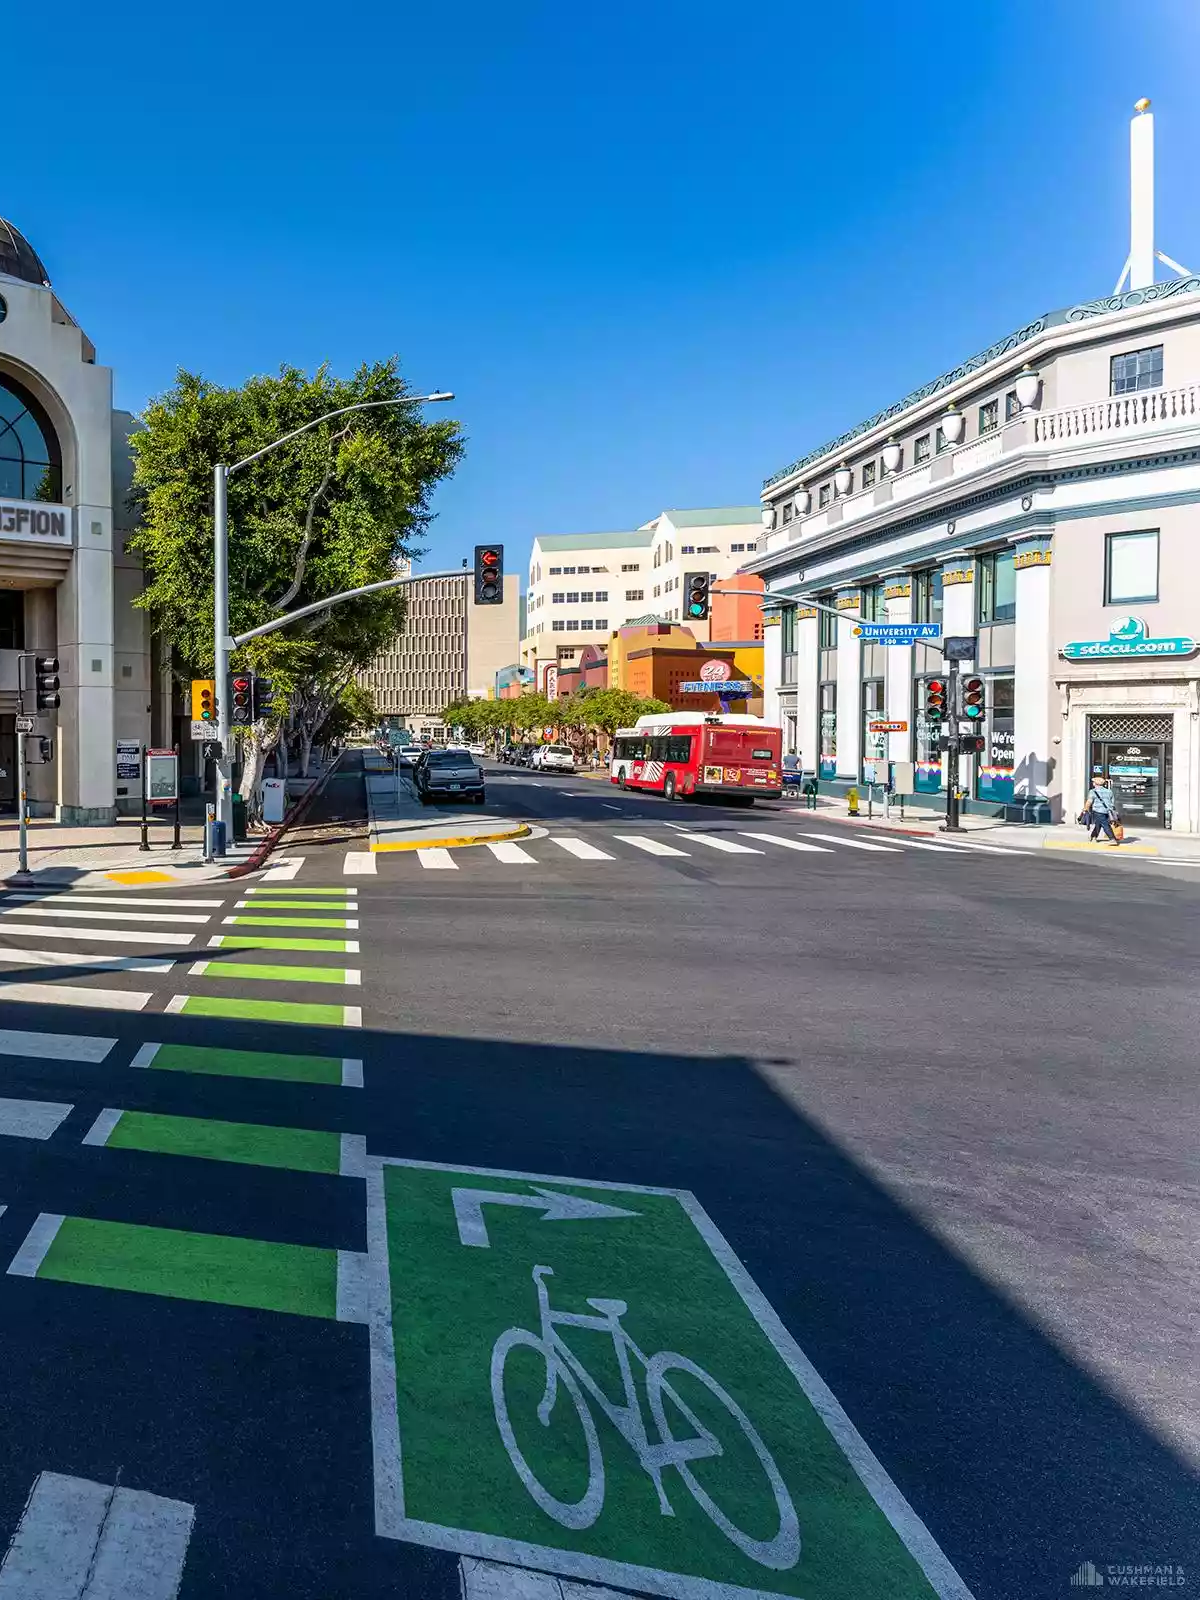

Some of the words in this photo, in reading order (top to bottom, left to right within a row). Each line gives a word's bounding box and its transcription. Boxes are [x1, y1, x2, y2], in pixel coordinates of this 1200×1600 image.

[864, 627, 918, 636] UNIVERSITY
[921, 627, 937, 635] AV.
[1079, 642, 1176, 655] sdccu.com
[703, 665, 725, 676] 24
[991, 731, 1015, 744] We're
[991, 746, 1014, 761] Open
